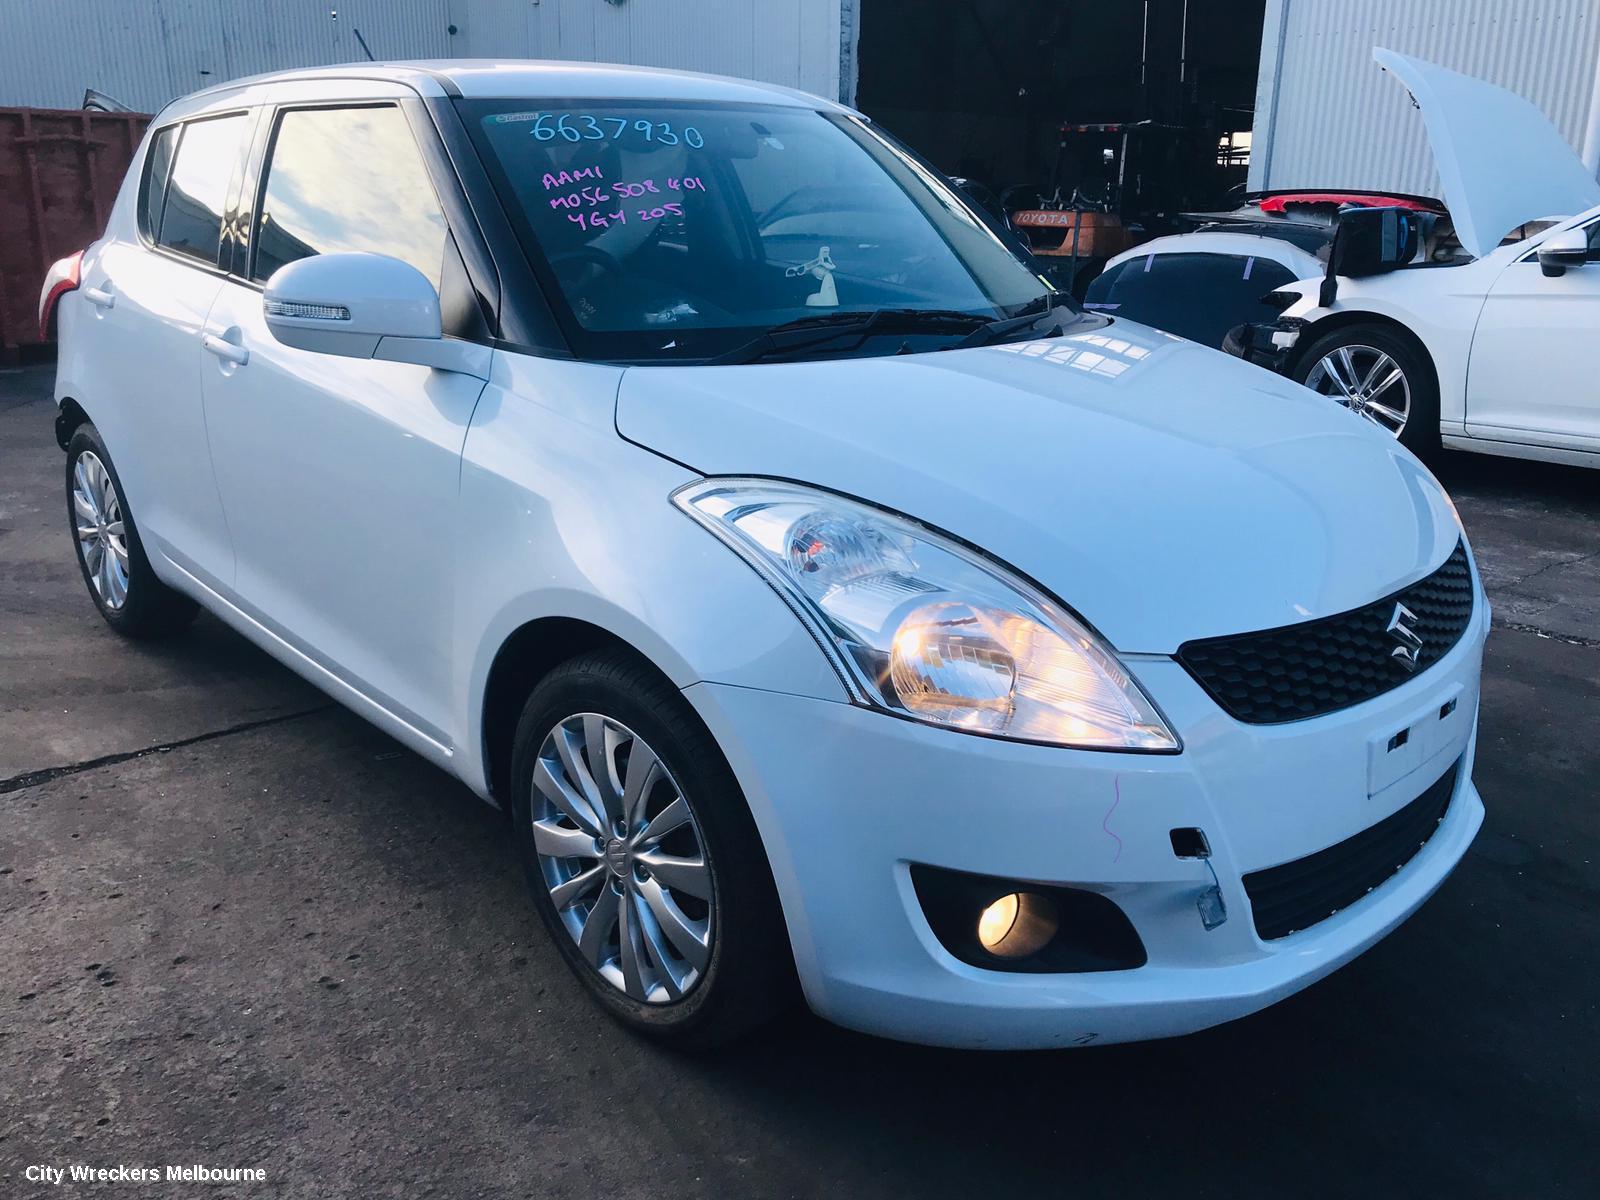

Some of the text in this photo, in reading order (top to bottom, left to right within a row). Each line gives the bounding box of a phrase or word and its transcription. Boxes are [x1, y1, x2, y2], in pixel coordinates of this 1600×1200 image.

[529, 114, 704, 149] 6637930
[612, 179, 660, 198] 508
[567, 203, 683, 231] YGY 205
[1016, 213, 1069, 225] TOYOTA
